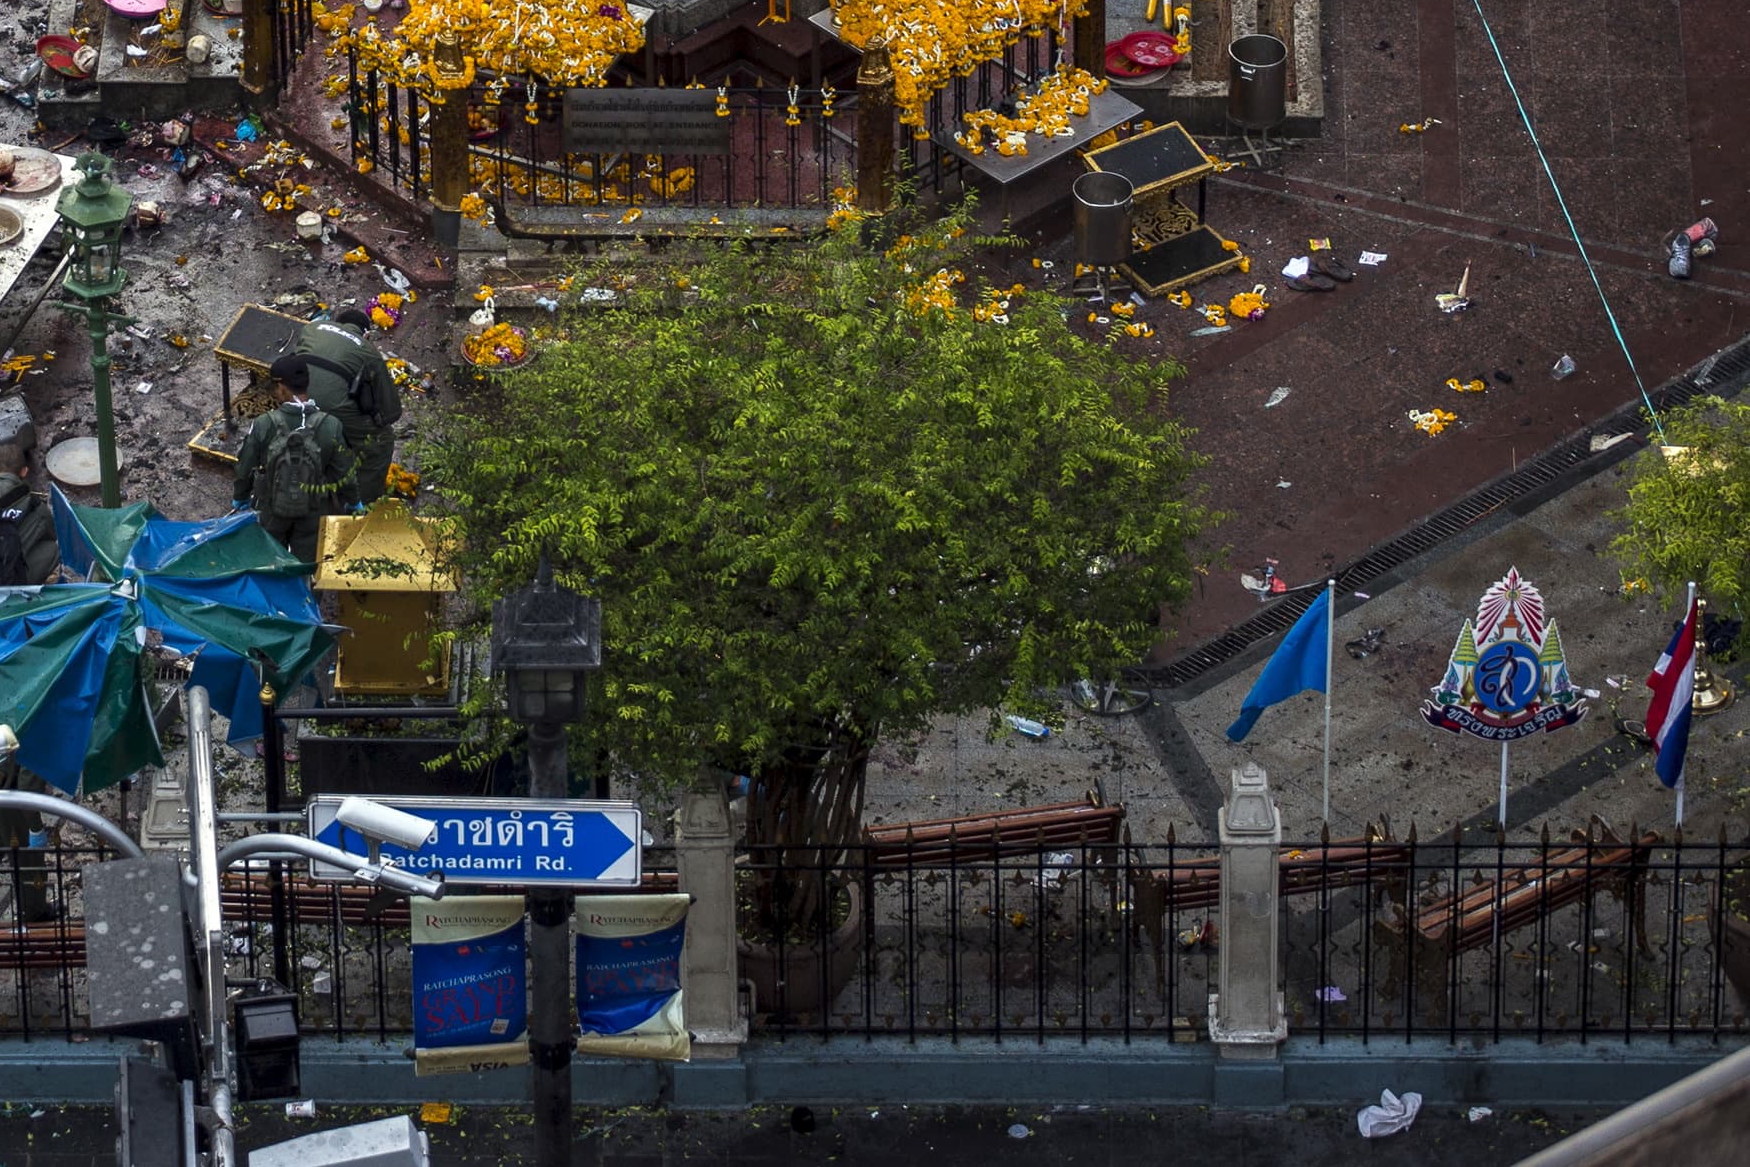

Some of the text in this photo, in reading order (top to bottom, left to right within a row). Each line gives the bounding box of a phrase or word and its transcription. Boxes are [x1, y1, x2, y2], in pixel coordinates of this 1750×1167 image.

[535, 854, 573, 872] Rd.
[422, 974, 517, 1013] GRAND
[423, 965, 513, 991] RATCHAPRASONG
[425, 993, 515, 1034] SALE
